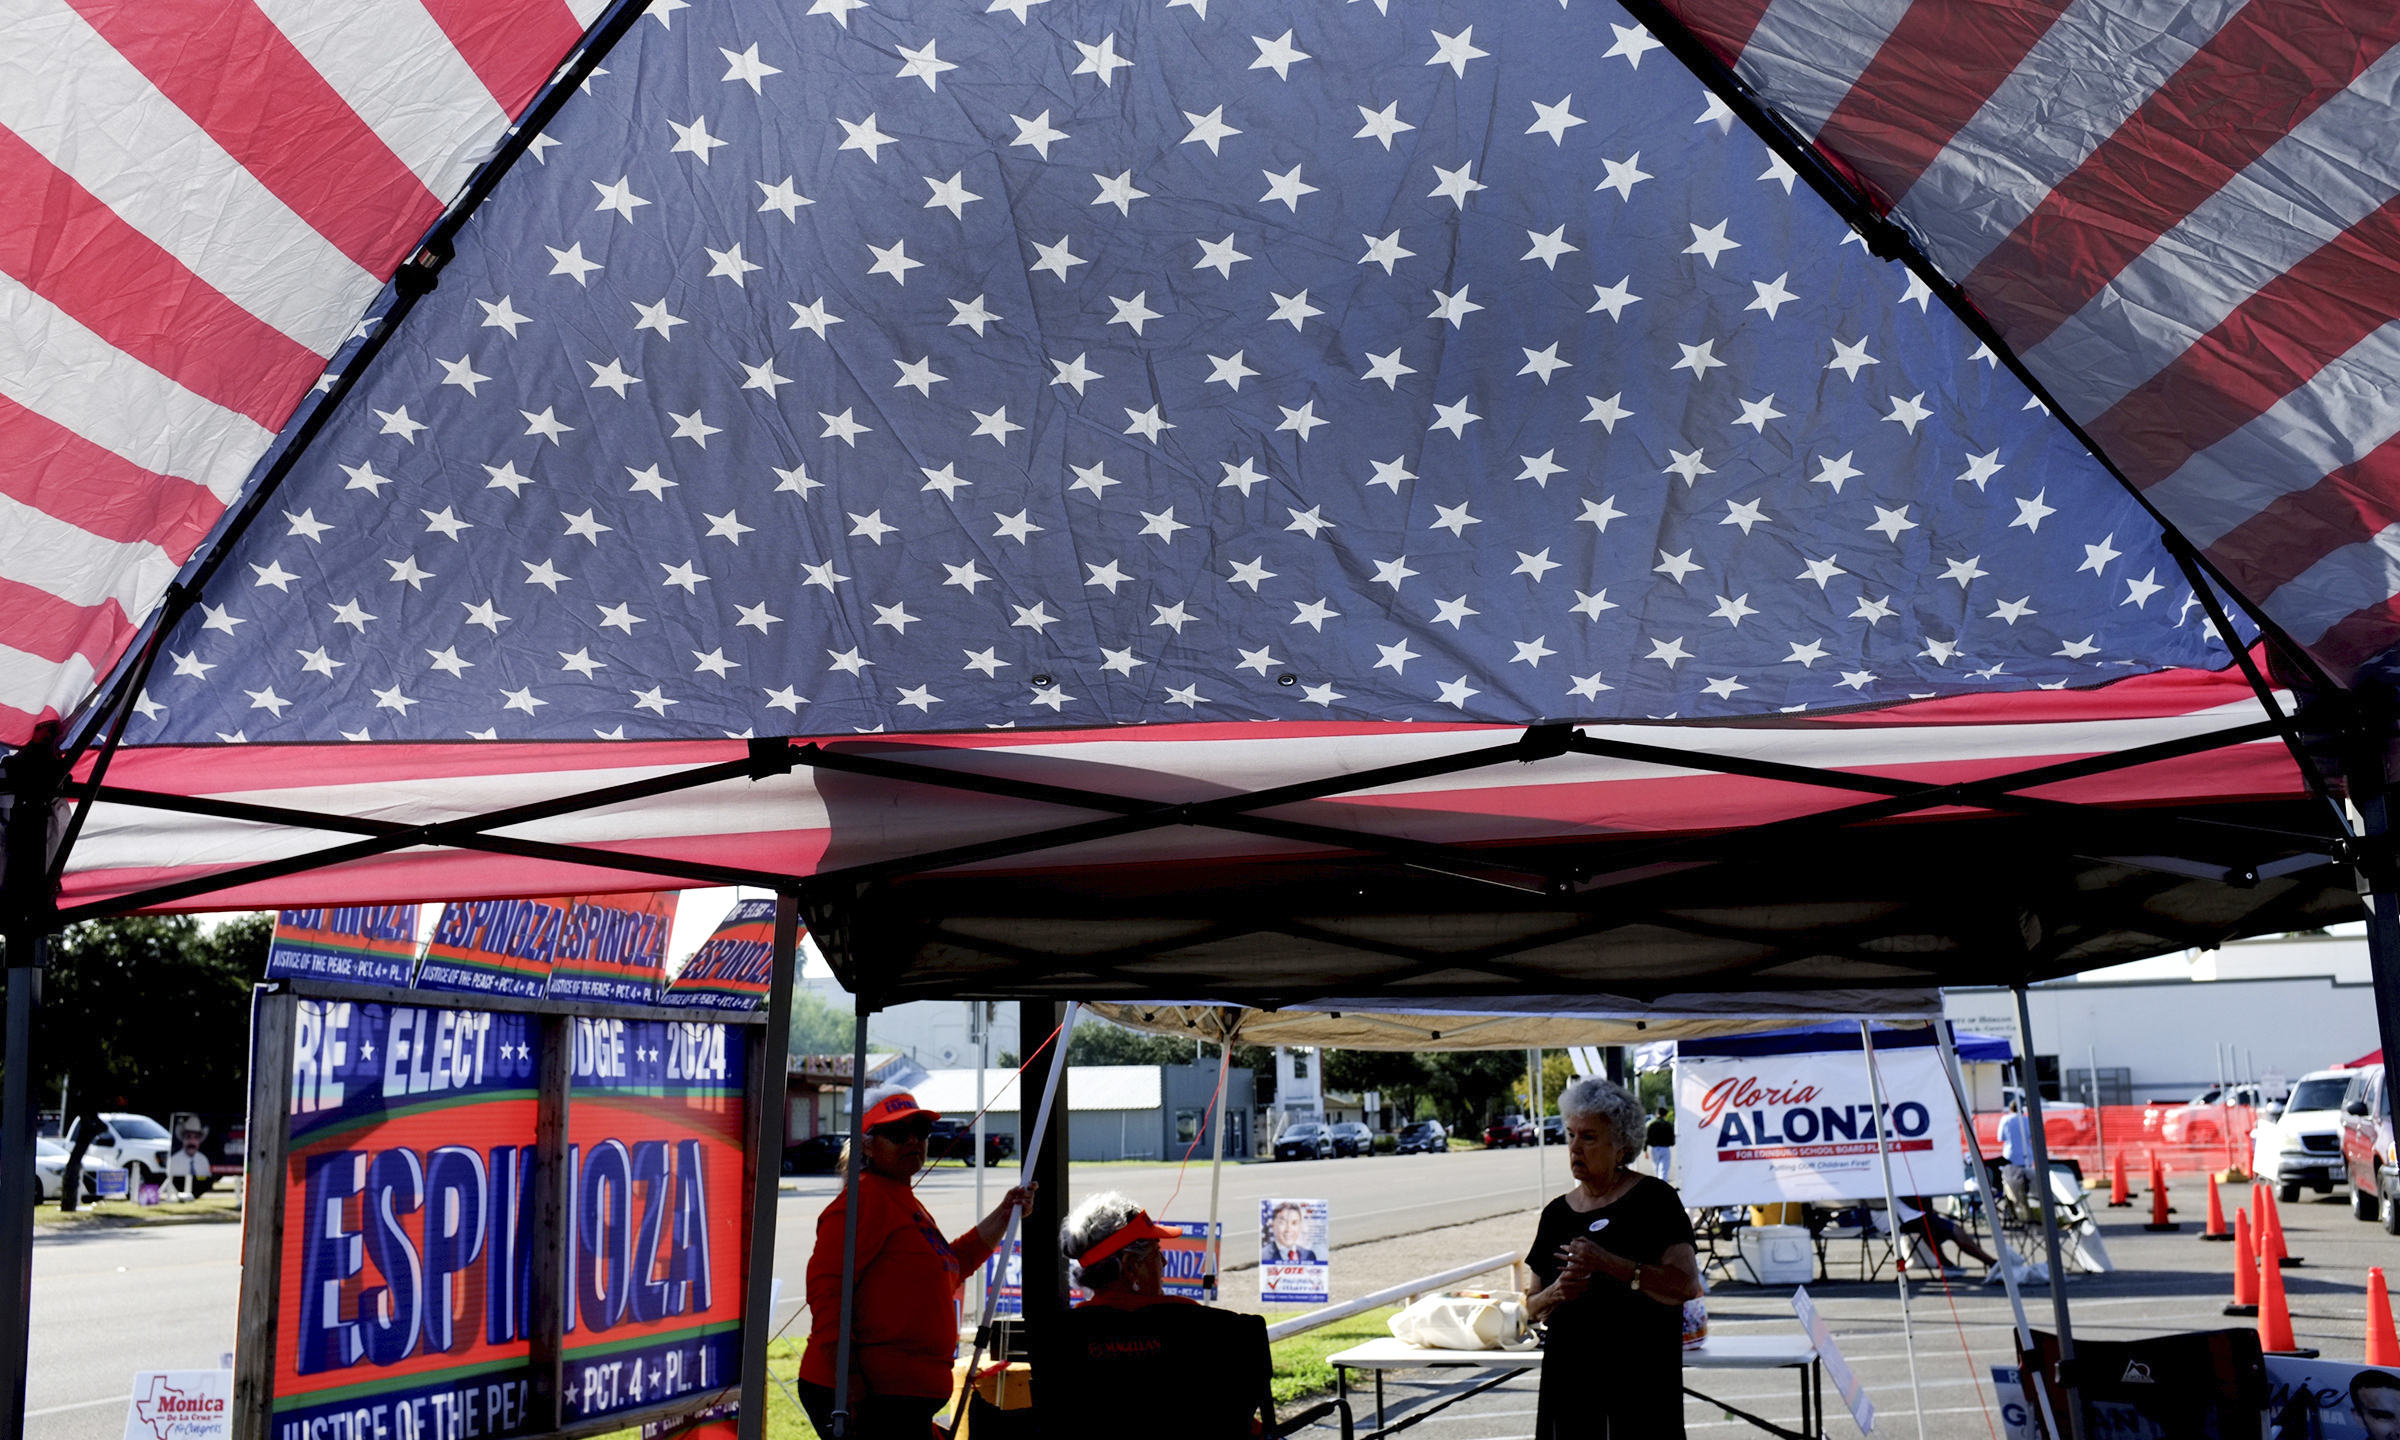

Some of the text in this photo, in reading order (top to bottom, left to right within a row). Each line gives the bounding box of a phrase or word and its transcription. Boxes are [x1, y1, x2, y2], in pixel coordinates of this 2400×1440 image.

[434, 899, 564, 963] ESPINOZA
[556, 903, 670, 969] ESPINOZA
[272, 950, 300, 969] JUSTICE
[301, 954, 310, 970] OF
[311, 955, 326, 972] THE
[327, 957, 351, 975] PEACE
[374, 963, 382, 977] 4
[421, 965, 449, 982] JUSTICE
[449, 969, 458, 983] OF
[458, 970, 472, 985] THE
[473, 972, 493, 989] PEACE
[513, 979, 521, 993] 4
[573, 980, 581, 995] OF
[581, 981, 591, 996] THE
[591, 982, 611, 997] PEACE
[630, 986, 637, 999] 4
[290, 1000, 352, 1115] RE
[382, 1007, 490, 1098] ELECT
[666, 1021, 727, 1081] 2024
[1698, 1076, 1823, 1129] Gloria
[1716, 1101, 1930, 1148] ALONZO
[1736, 1150, 1753, 1159] FOR
[1754, 1148, 1798, 1158] EDINBURG
[1800, 1146, 1834, 1156] SCHOOL
[1836, 1145, 1866, 1154] BOARD
[1817, 1161, 1849, 1169] Children
[1203, 1225, 1220, 1236] 24
[157, 1392, 224, 1412] Monica
[395, 1397, 427, 1440] OF
[431, 1388, 480, 1440] THE
[583, 1361, 625, 1414] PCT.
[629, 1355, 643, 1402] 4
[664, 1357, 692, 1398] PL.
[697, 1344, 709, 1388] 1
